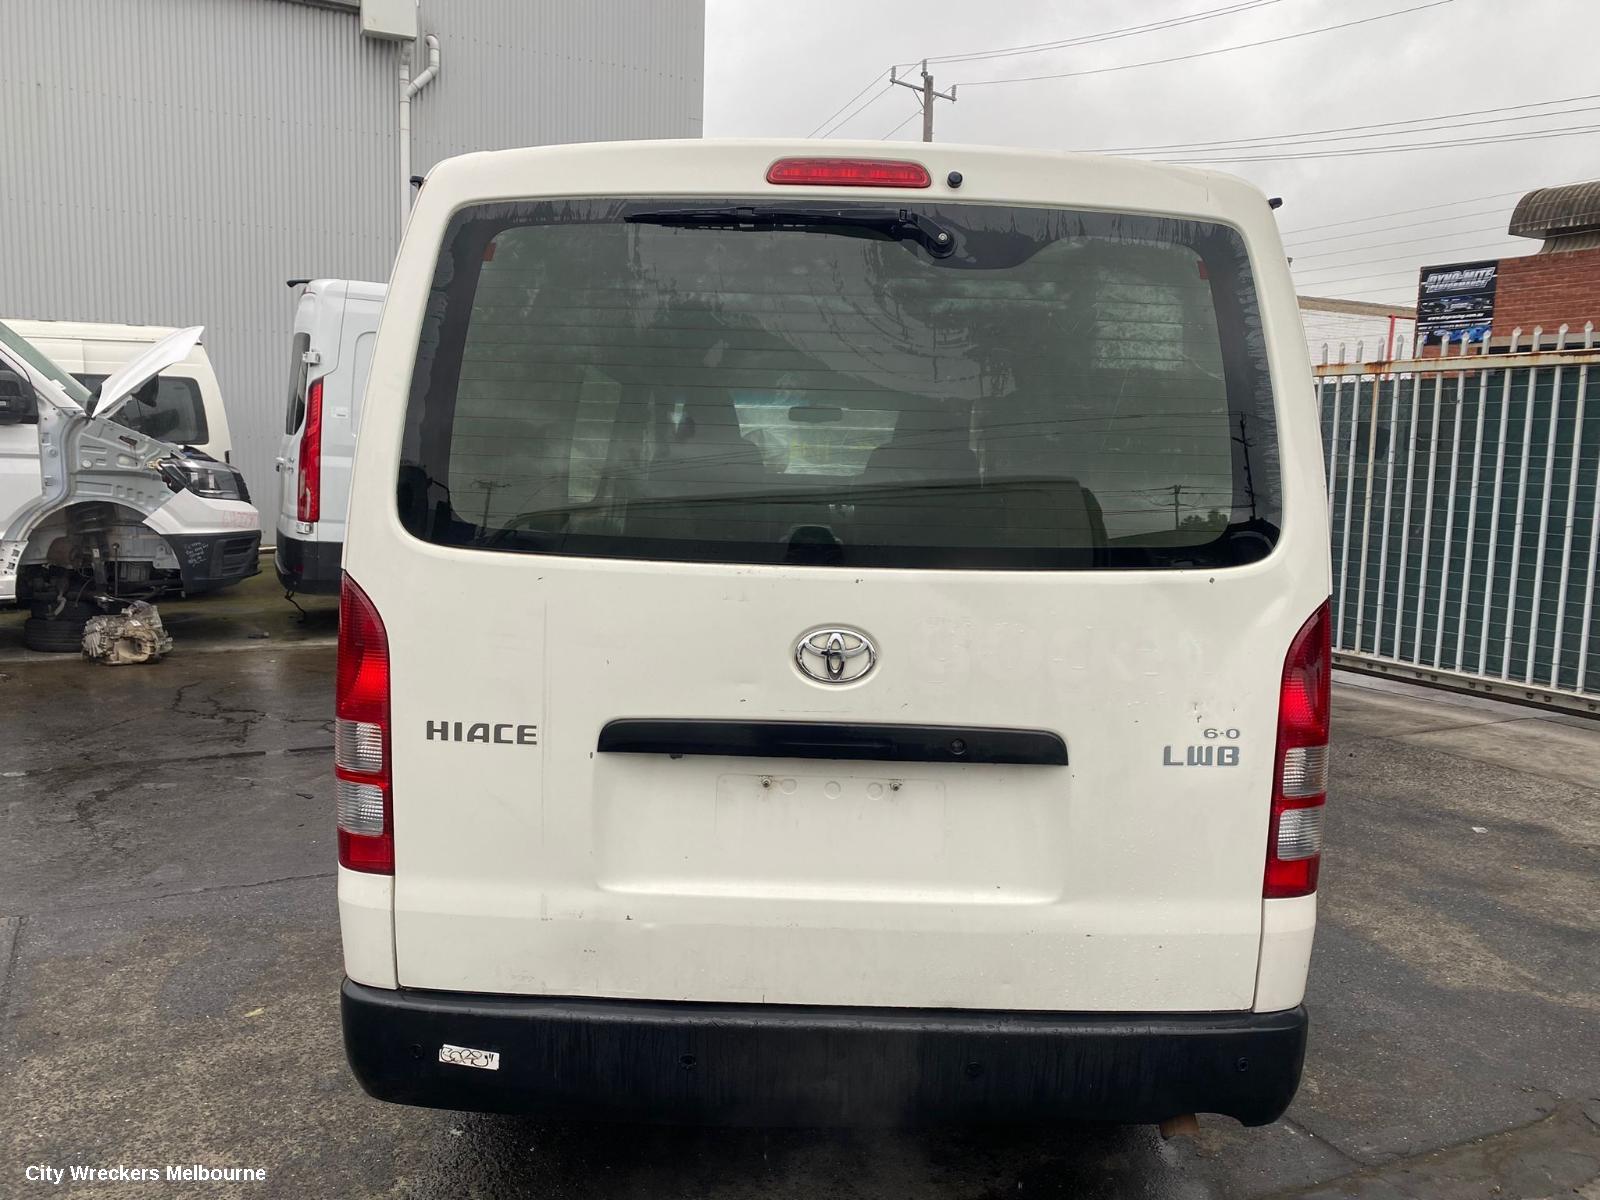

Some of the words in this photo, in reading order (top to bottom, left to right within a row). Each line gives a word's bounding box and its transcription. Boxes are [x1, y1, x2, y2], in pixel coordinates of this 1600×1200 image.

[1427, 267, 1495, 285] DYNO-MITE
[1427, 280, 1486, 292] PERFORMANCE
[426, 720, 537, 745] HIACE
[1163, 745, 1240, 766] LWB
